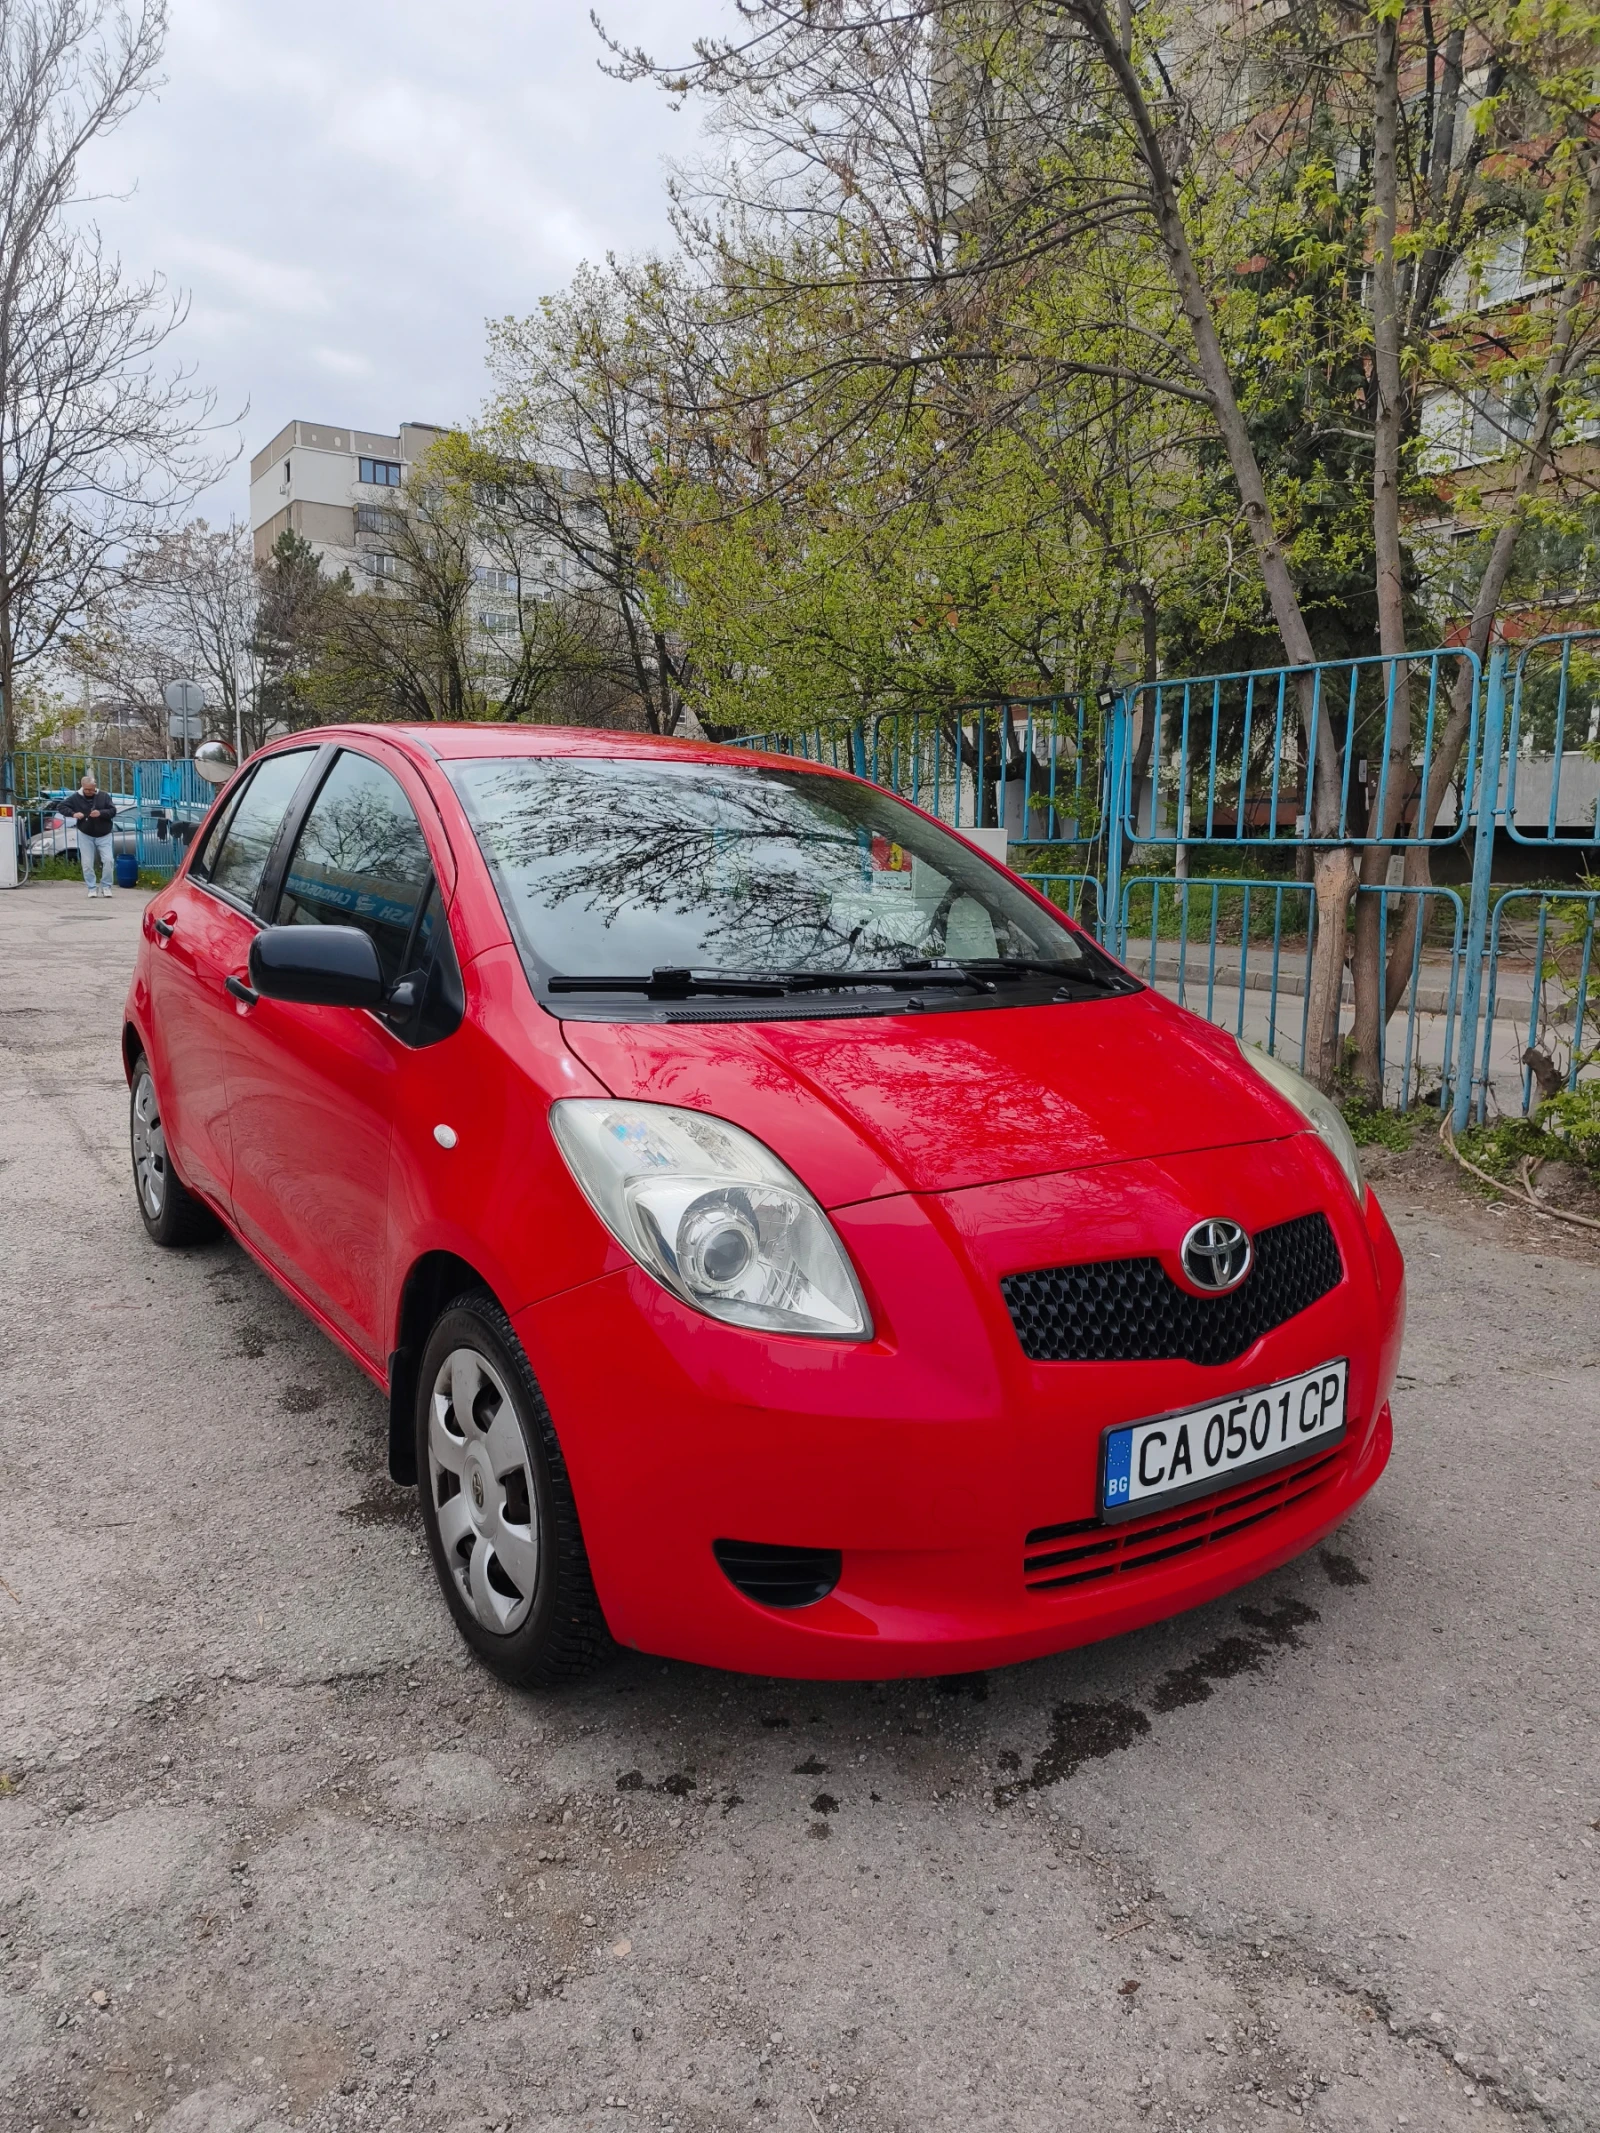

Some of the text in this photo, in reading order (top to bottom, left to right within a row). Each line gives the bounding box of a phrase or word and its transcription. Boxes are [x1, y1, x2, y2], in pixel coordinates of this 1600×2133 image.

[1138, 1373, 1340, 1487] CA 0501 CP
[1108, 1476, 1128, 1496] BG
